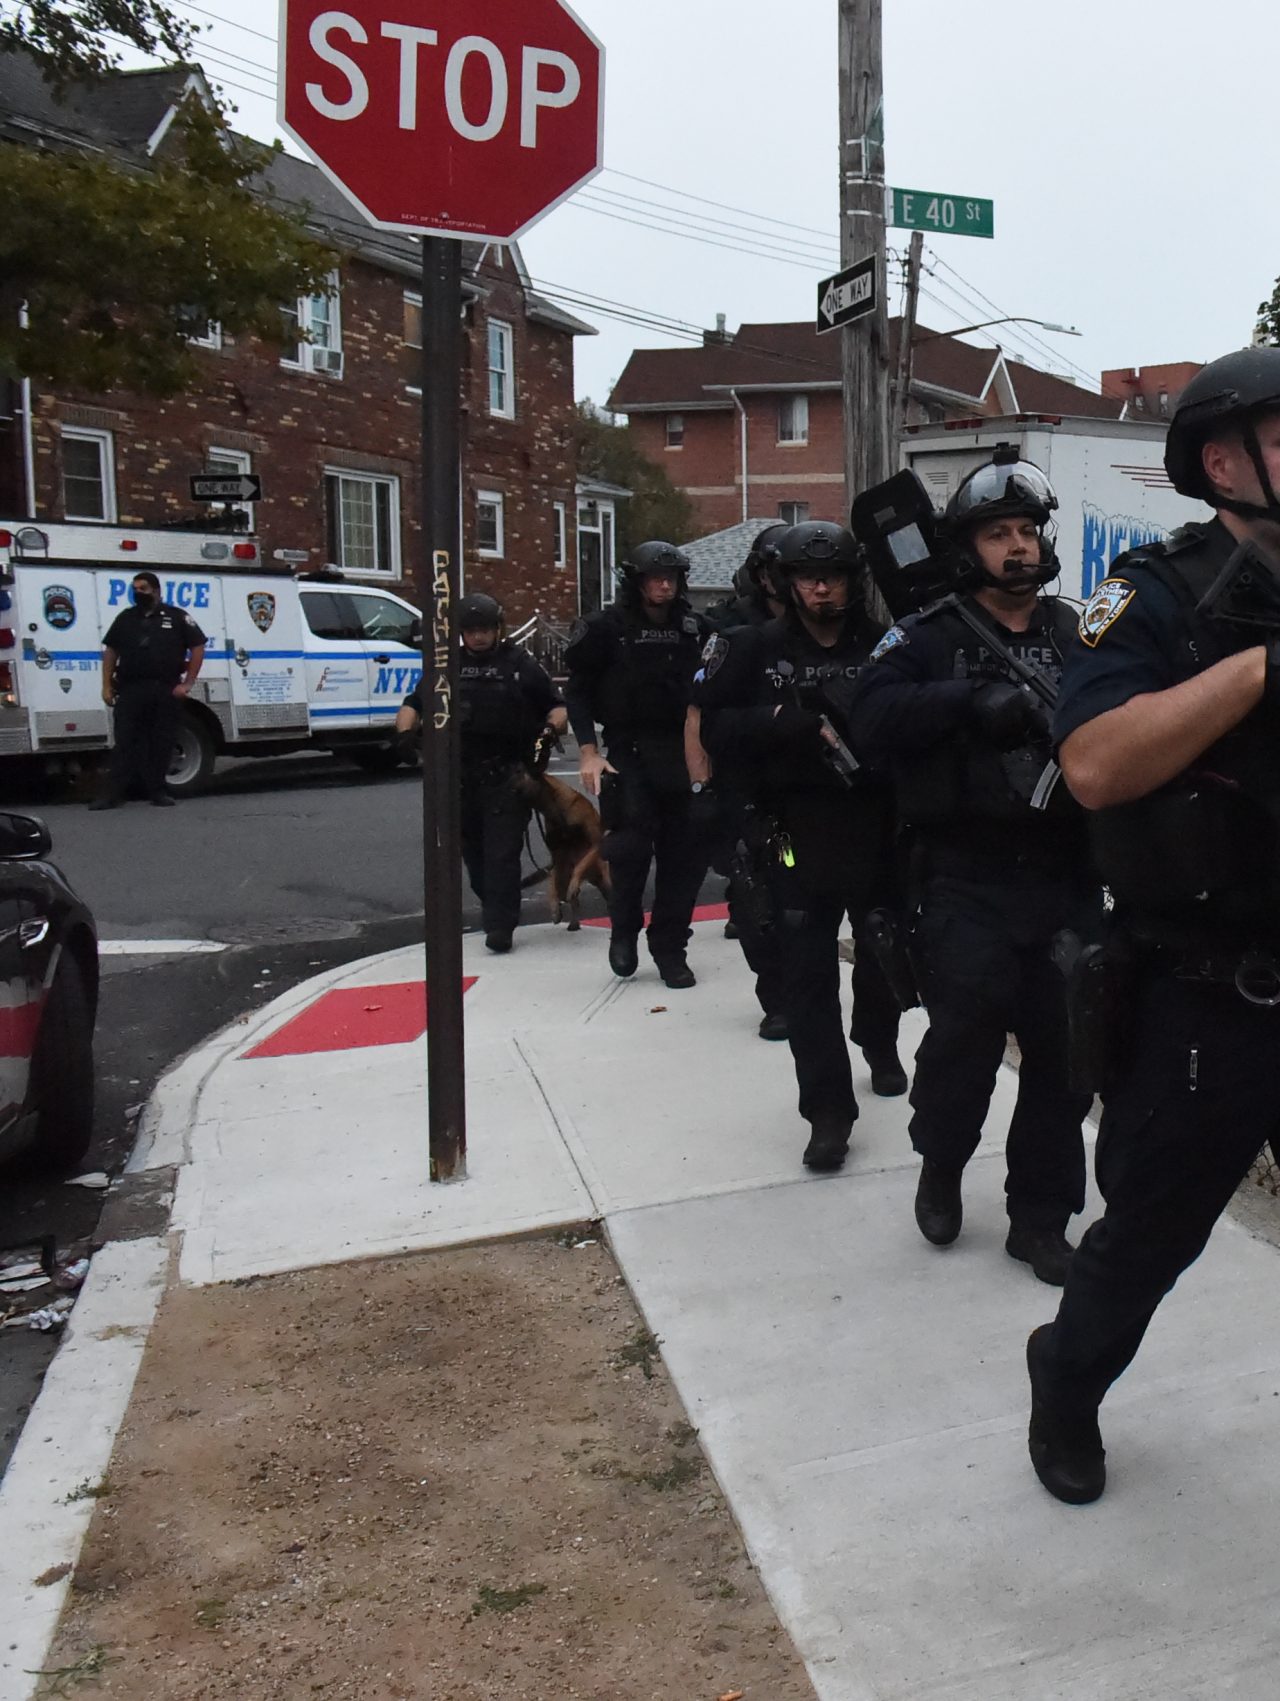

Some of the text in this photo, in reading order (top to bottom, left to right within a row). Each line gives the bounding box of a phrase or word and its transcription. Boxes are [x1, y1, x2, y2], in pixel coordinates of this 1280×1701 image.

[305, 11, 581, 148] STOP
[903, 194, 982, 228] E 40 St
[826, 275, 870, 308] ONE WAY
[198, 482, 241, 494] ONE WAY
[107, 579, 210, 608] PICE
[978, 646, 1052, 663] PLICE
